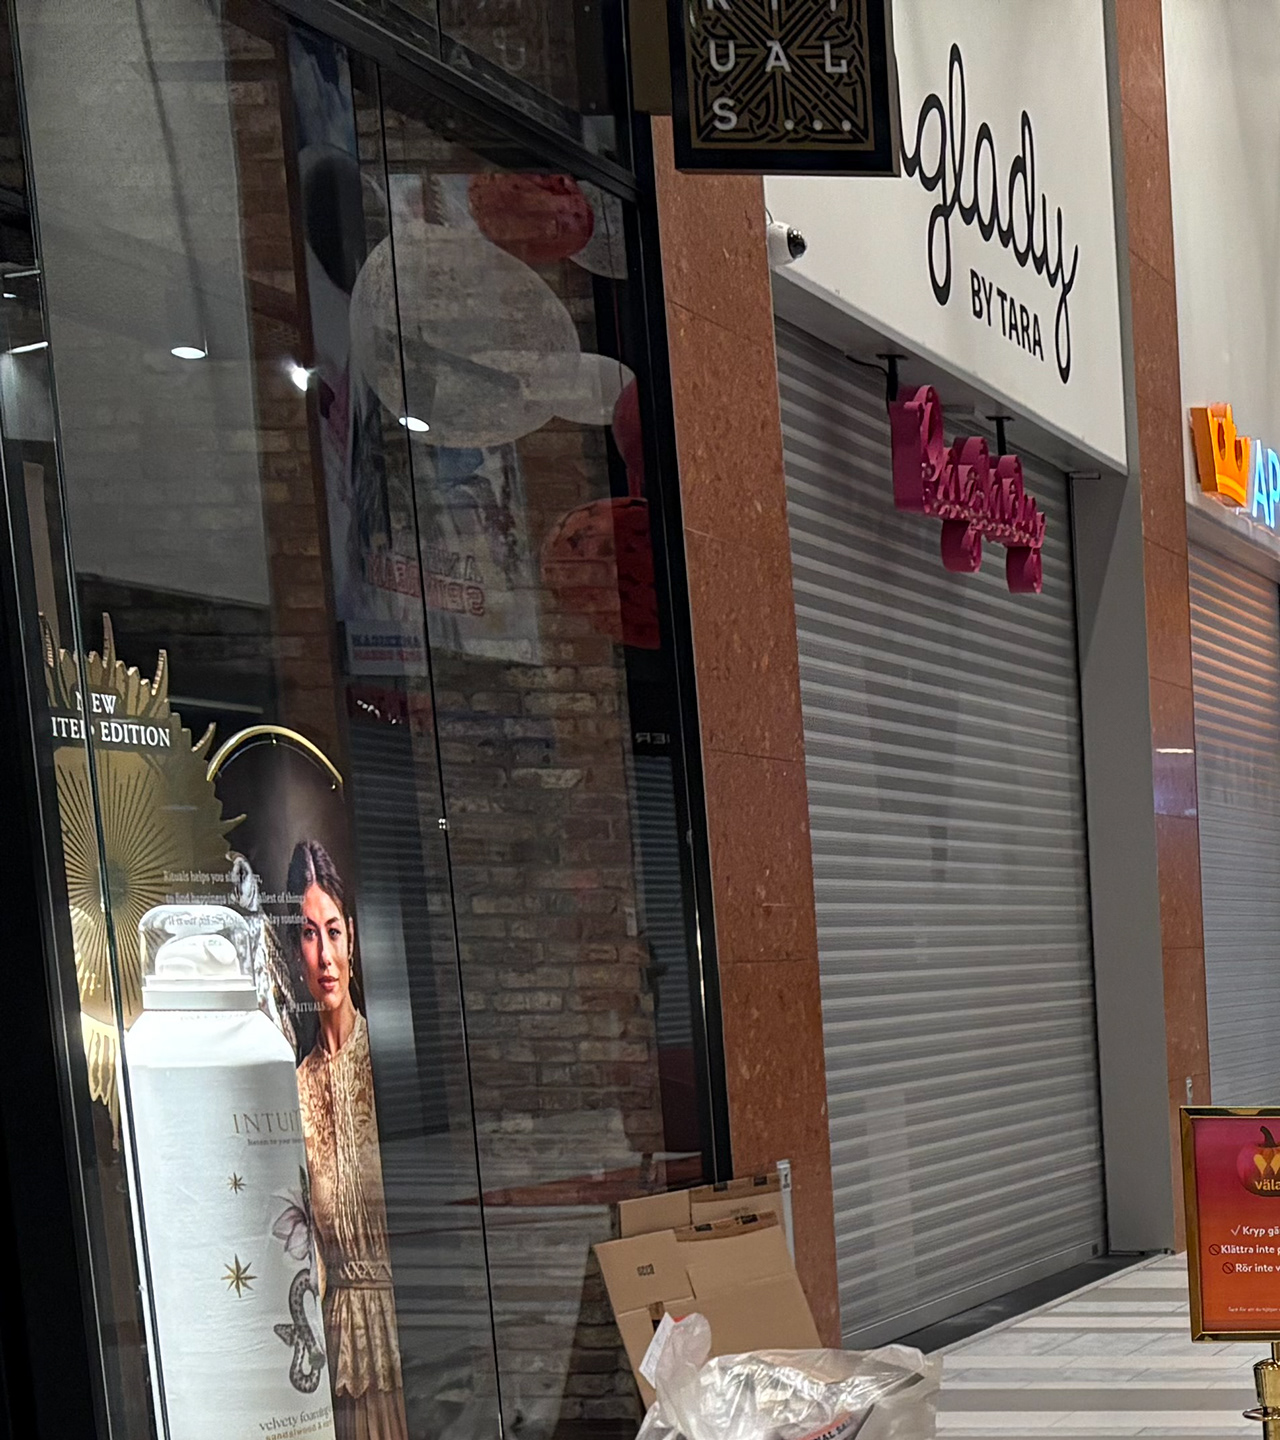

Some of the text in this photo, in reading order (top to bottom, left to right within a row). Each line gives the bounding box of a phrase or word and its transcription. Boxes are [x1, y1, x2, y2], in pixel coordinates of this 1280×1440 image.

[899, 42, 1078, 384] glady
[970, 268, 1044, 362] BY TARA
[100, 721, 171, 747] EDITION
[1242, 1226, 1265, 1237] Kryp
[1221, 1245, 1254, 1254] Klättra
[1256, 1245, 1274, 1254] inte
[1236, 1263, 1252, 1272] Rör
[1255, 1263, 1273, 1272] inte
